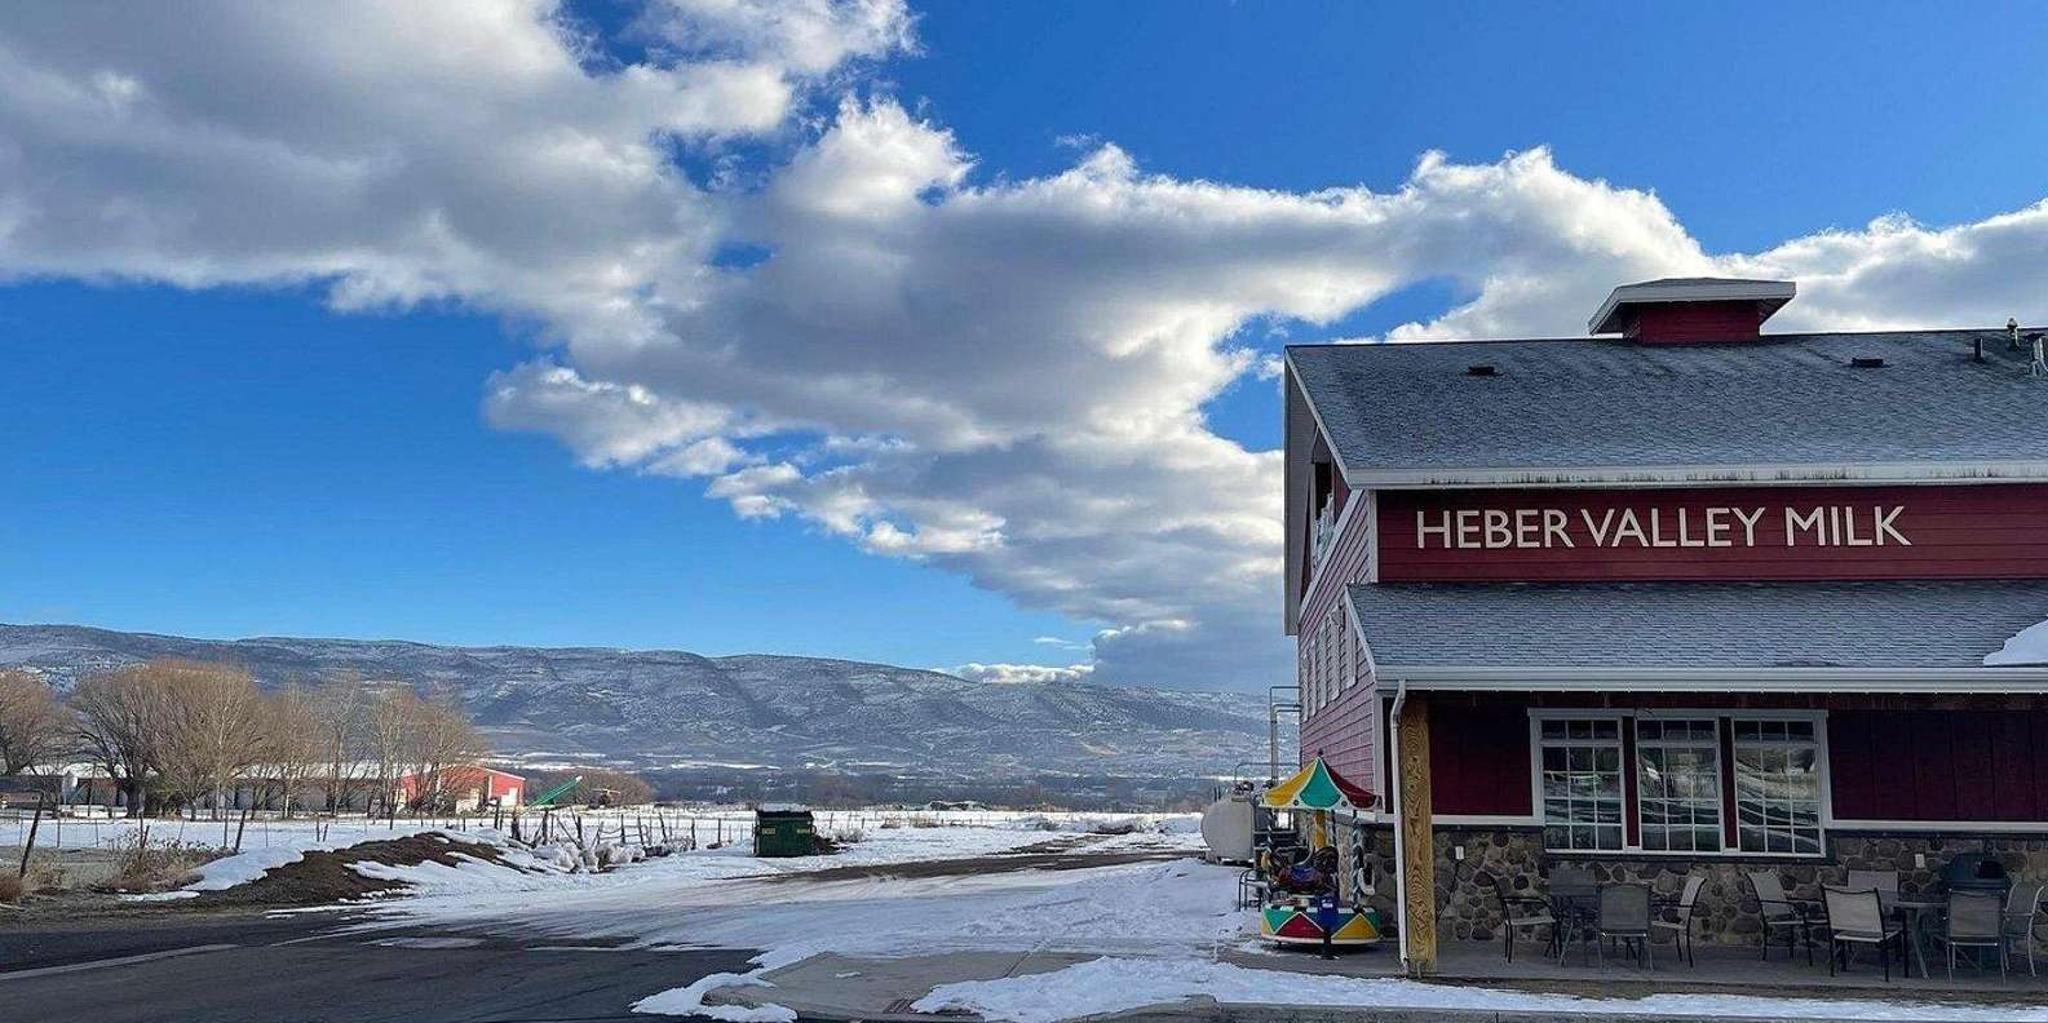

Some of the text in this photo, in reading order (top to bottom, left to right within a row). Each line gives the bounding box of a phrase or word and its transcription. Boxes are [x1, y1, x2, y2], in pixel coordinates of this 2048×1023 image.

[1417, 505, 1912, 549] HEBER VALLEY MILK
